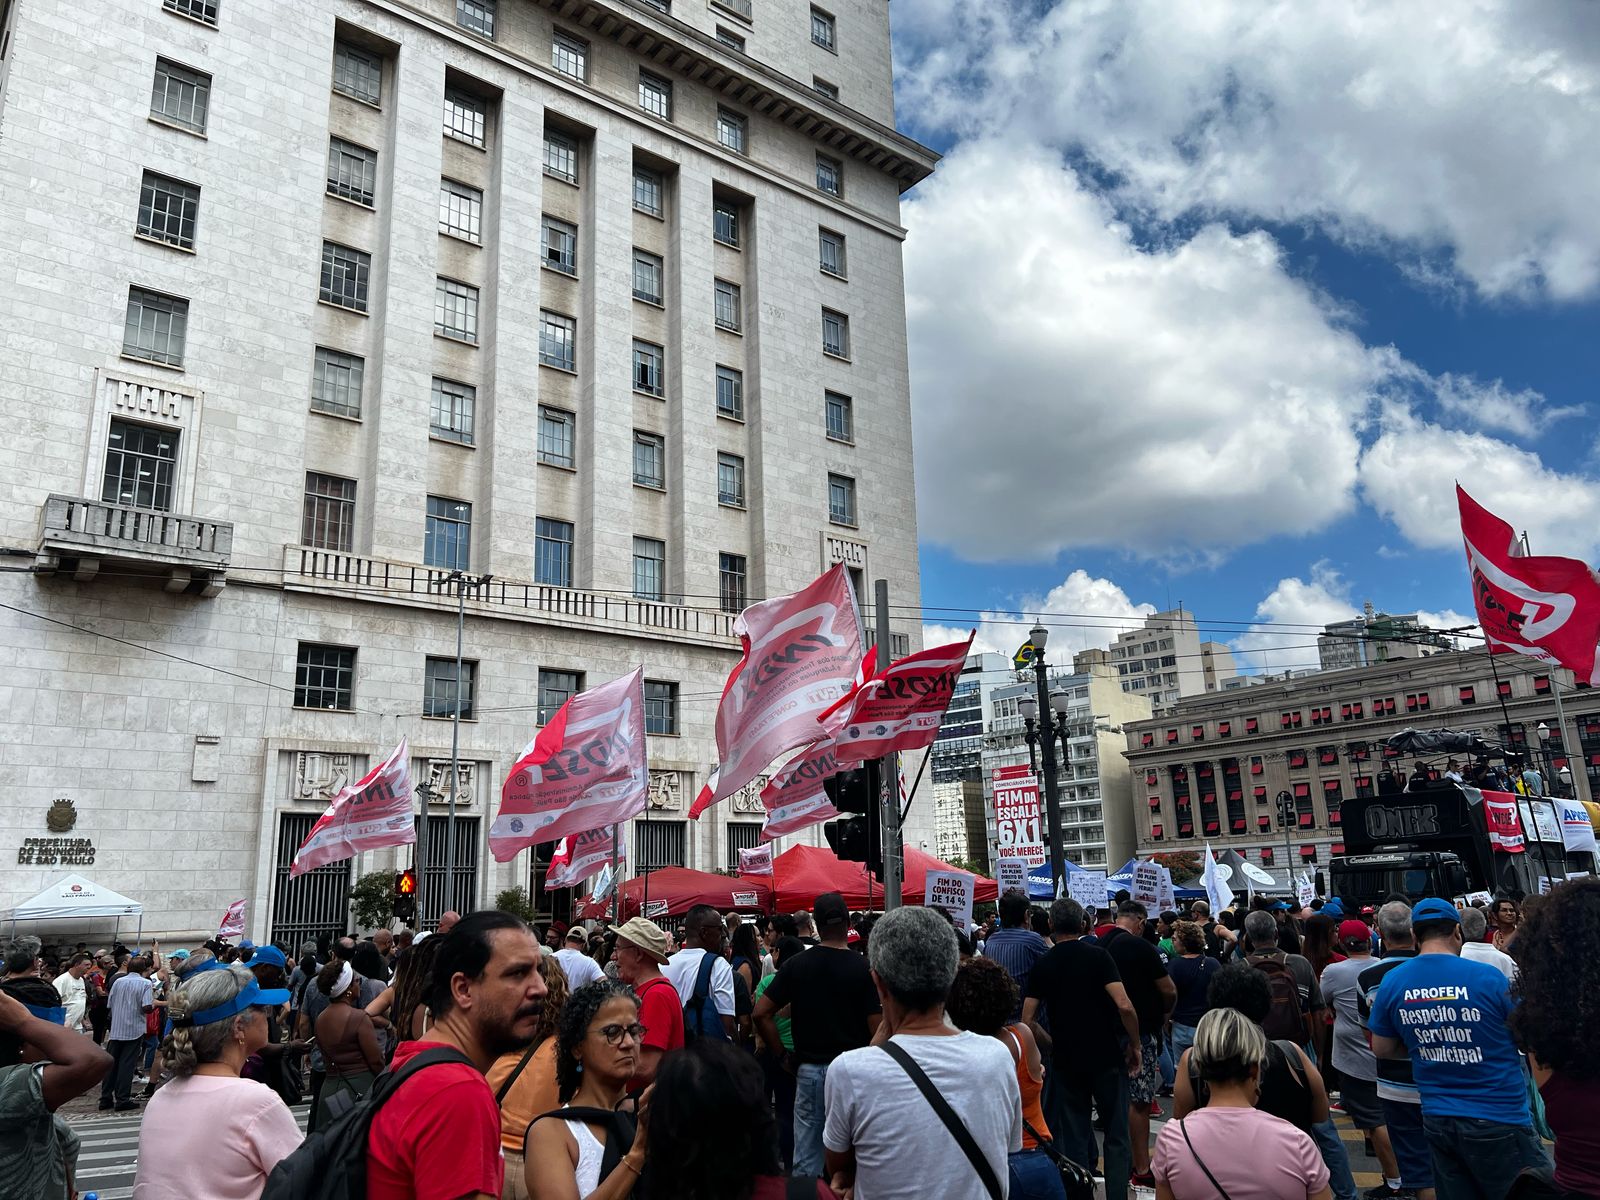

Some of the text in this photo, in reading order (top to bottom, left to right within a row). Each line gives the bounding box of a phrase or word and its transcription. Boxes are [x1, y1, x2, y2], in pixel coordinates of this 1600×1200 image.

[996, 789, 1037, 807] FIM DA
[997, 804, 1039, 820] ESCALA
[998, 817, 1041, 847] 6X1
[24, 837, 92, 847] PREFEITURA
[19, 847, 35, 856] DO
[1017, 845, 1044, 857] MERECE
[18, 855, 33, 865] DE
[60, 856, 95, 865] PAULO
[937, 878, 962, 888] FIM DO
[932, 886, 966, 897] CONFISCO
[931, 894, 943, 903] DE
[945, 895, 955, 904] 14
[1404, 986, 1468, 1001] APROFEM
[1399, 1005, 1481, 1026] Respeito ao
[1414, 1026, 1472, 1044] Servidor
[1417, 1046, 1483, 1065] Municipal
